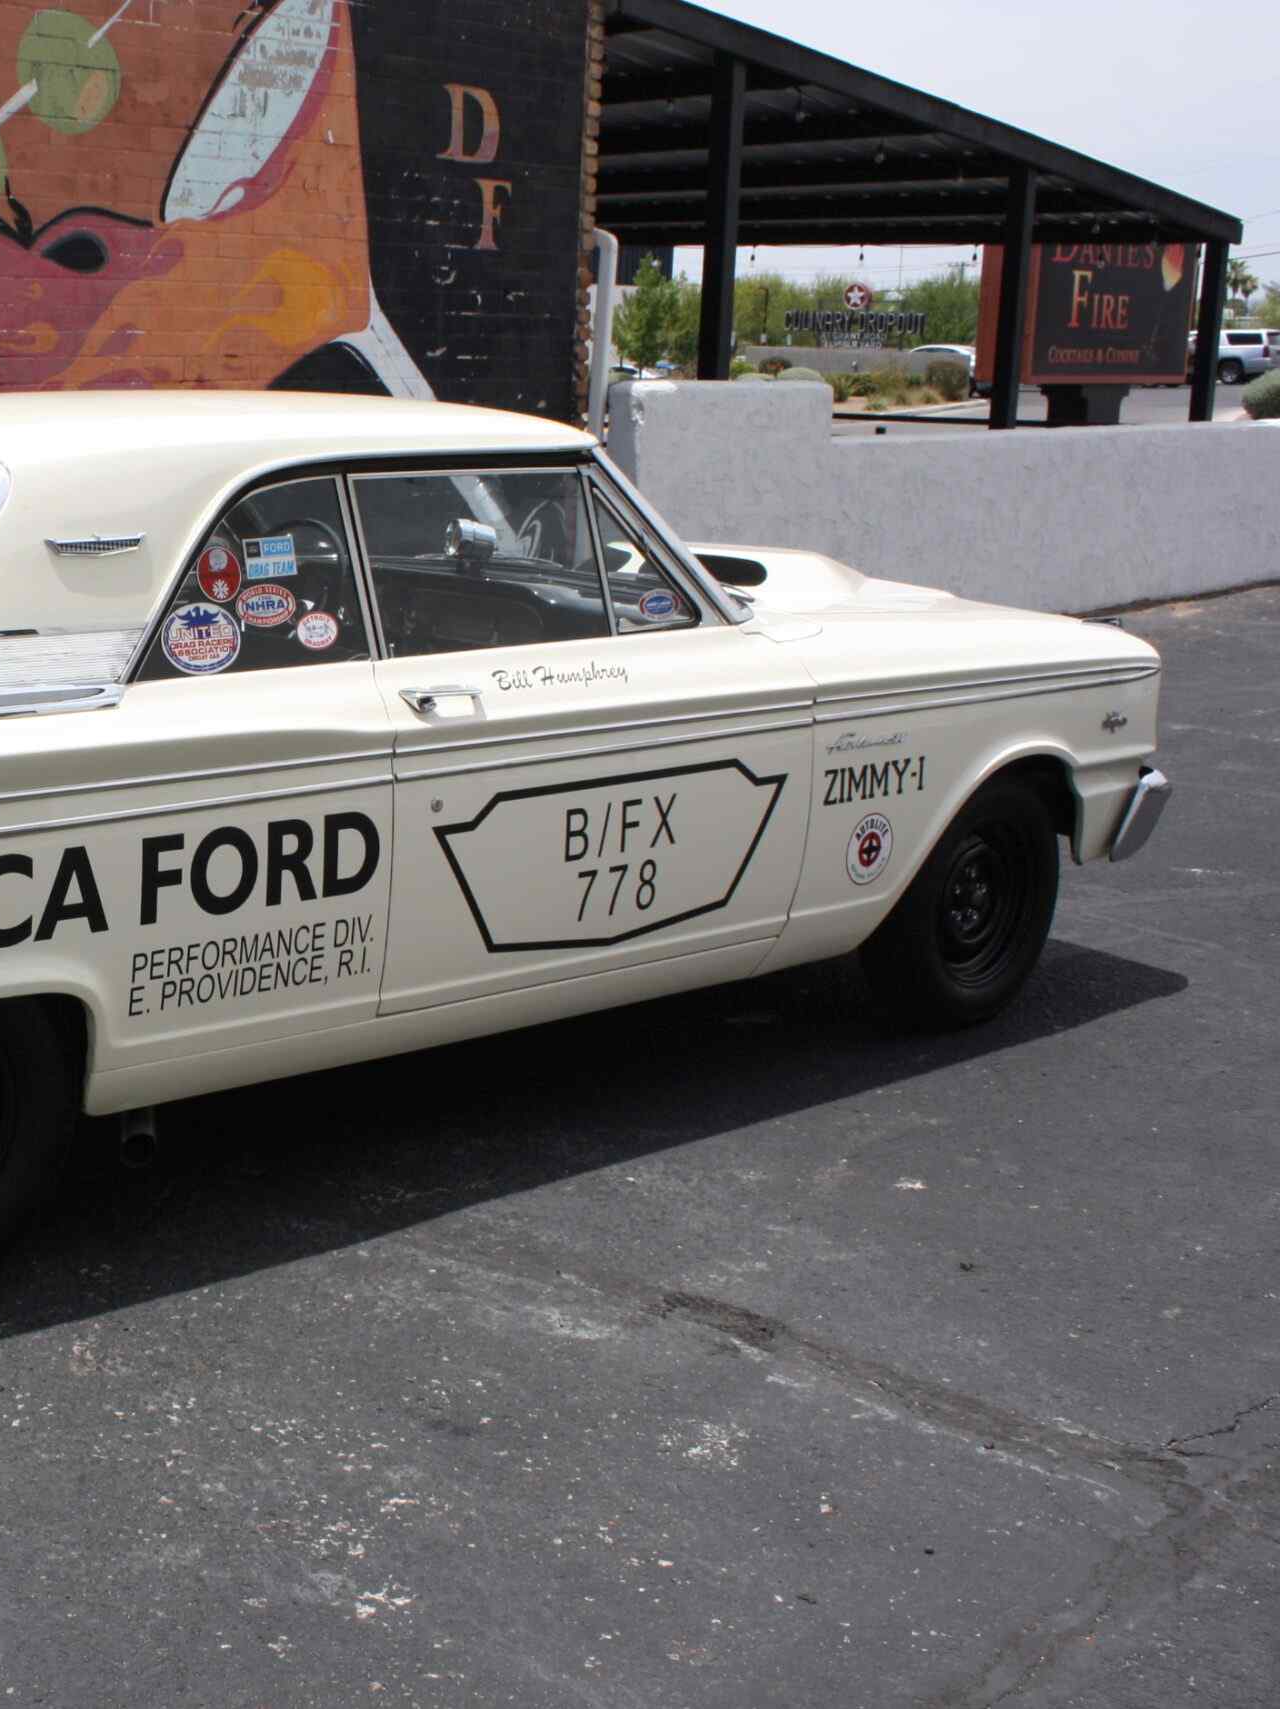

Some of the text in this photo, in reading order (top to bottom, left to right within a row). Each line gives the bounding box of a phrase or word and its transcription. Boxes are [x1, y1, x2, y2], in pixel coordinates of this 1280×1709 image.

[436, 84, 500, 163] D
[473, 178, 512, 250] F
[1067, 269, 1130, 329] FIRE
[263, 542, 291, 553] FORD
[272, 560, 296, 576] TEAM
[169, 624, 233, 641] UNITED
[245, 599, 285, 611] NHRA
[492, 660, 629, 691] Bill Humphrey
[564, 793, 677, 862] B/FX
[139, 811, 381, 926] FORD
[577, 858, 657, 922] 778
[131, 914, 374, 984] PERFORMANCE DIV.
[128, 946, 371, 1017] E. PROVIDENCE, R.I.
